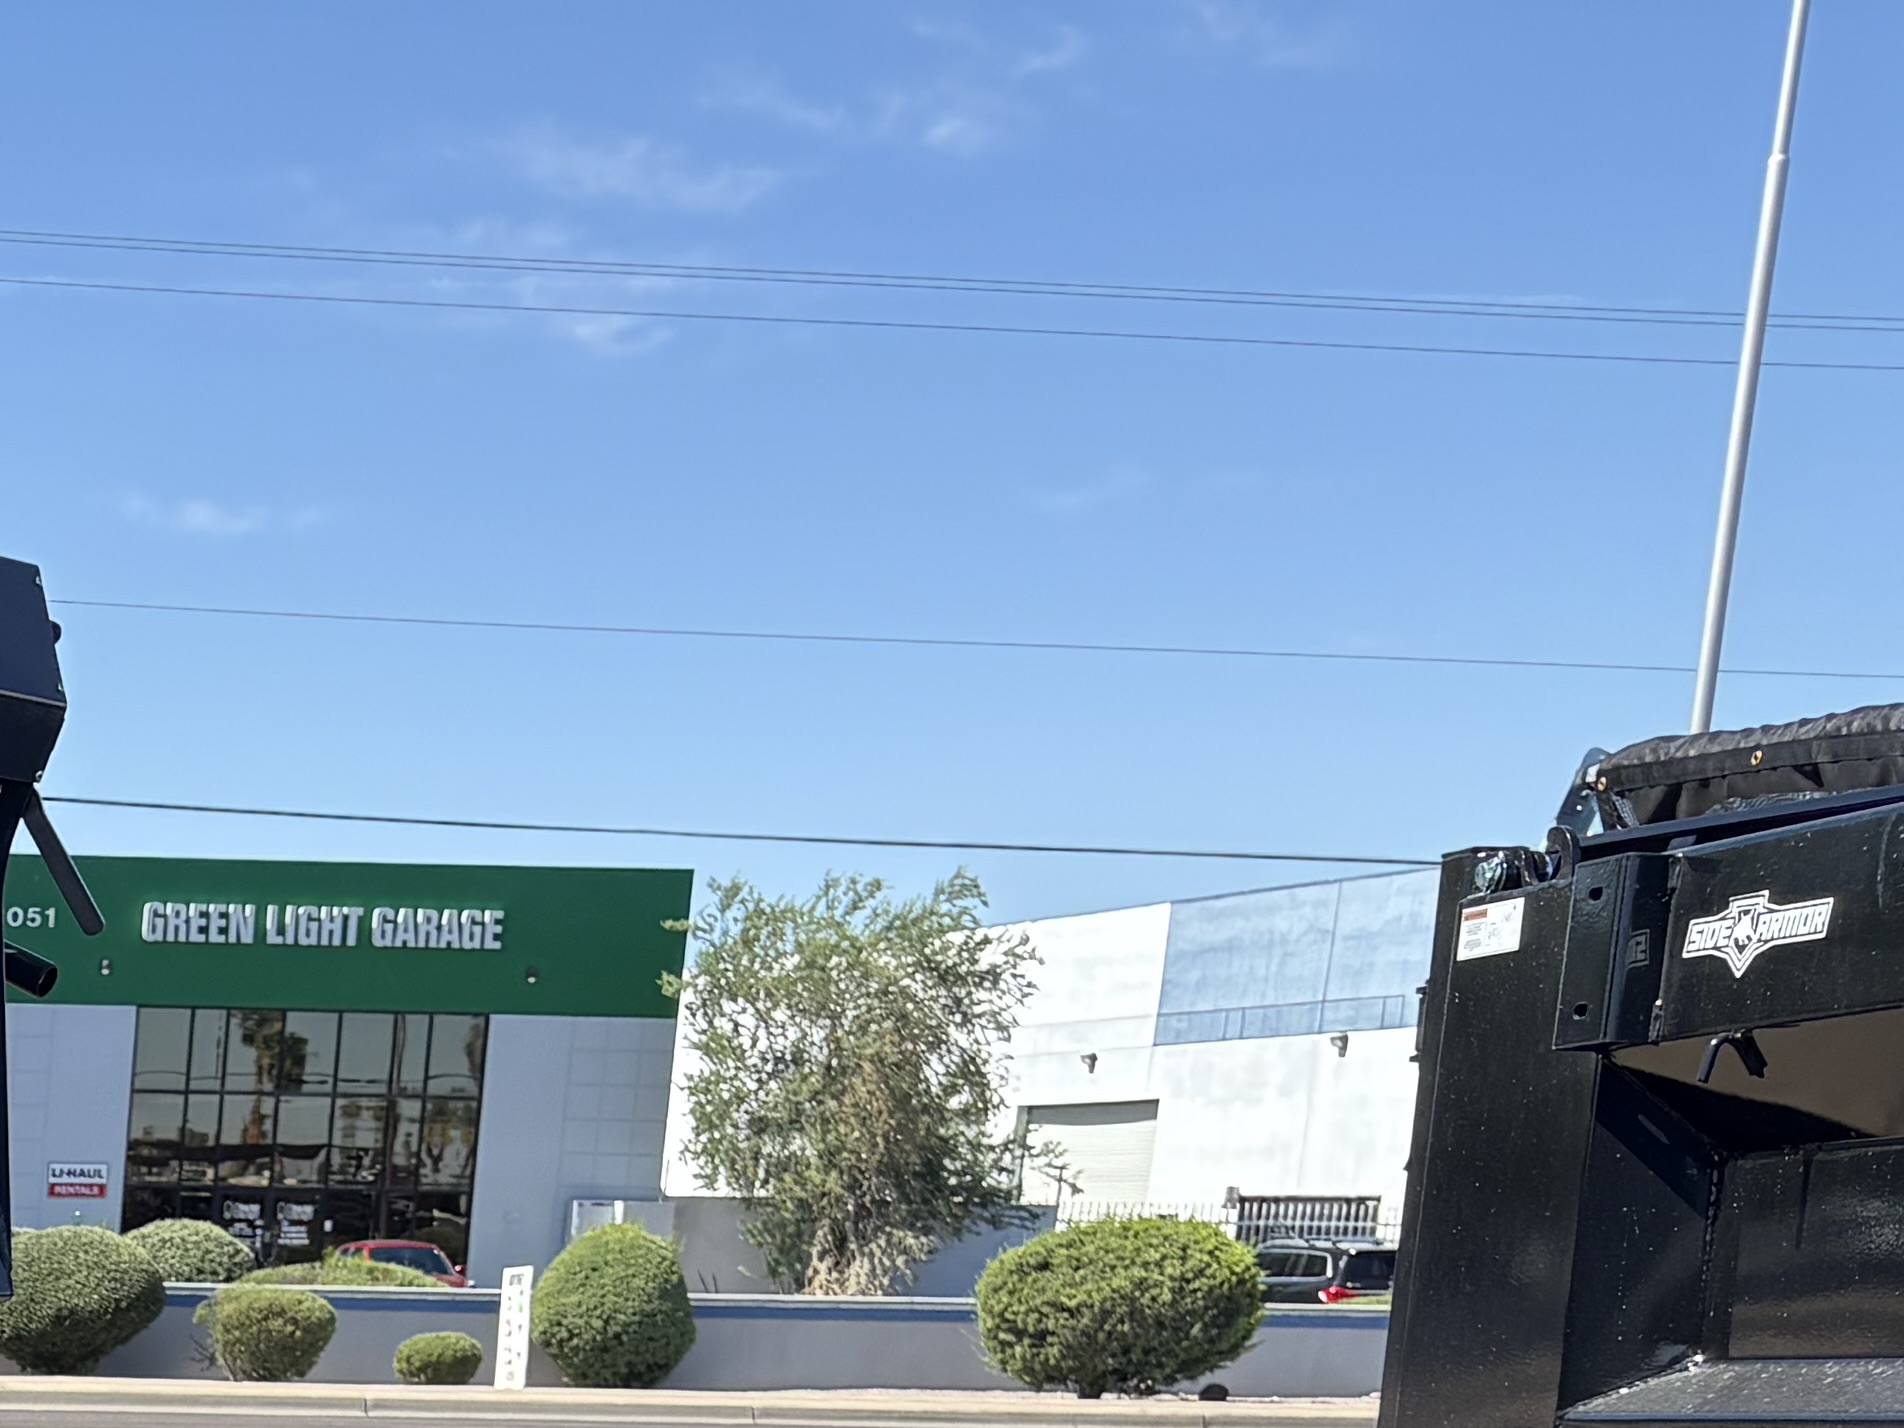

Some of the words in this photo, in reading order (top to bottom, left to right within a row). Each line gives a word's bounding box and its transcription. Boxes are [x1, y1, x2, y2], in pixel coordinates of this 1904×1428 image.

[141, 901, 256, 944] GREEN
[266, 904, 364, 948] LIGHT
[371, 906, 505, 951] GARAGE
[1687, 918, 1735, 952] SIDE
[1754, 904, 1830, 942] ARMOR
[51, 1167, 105, 1179] U-HAUL
